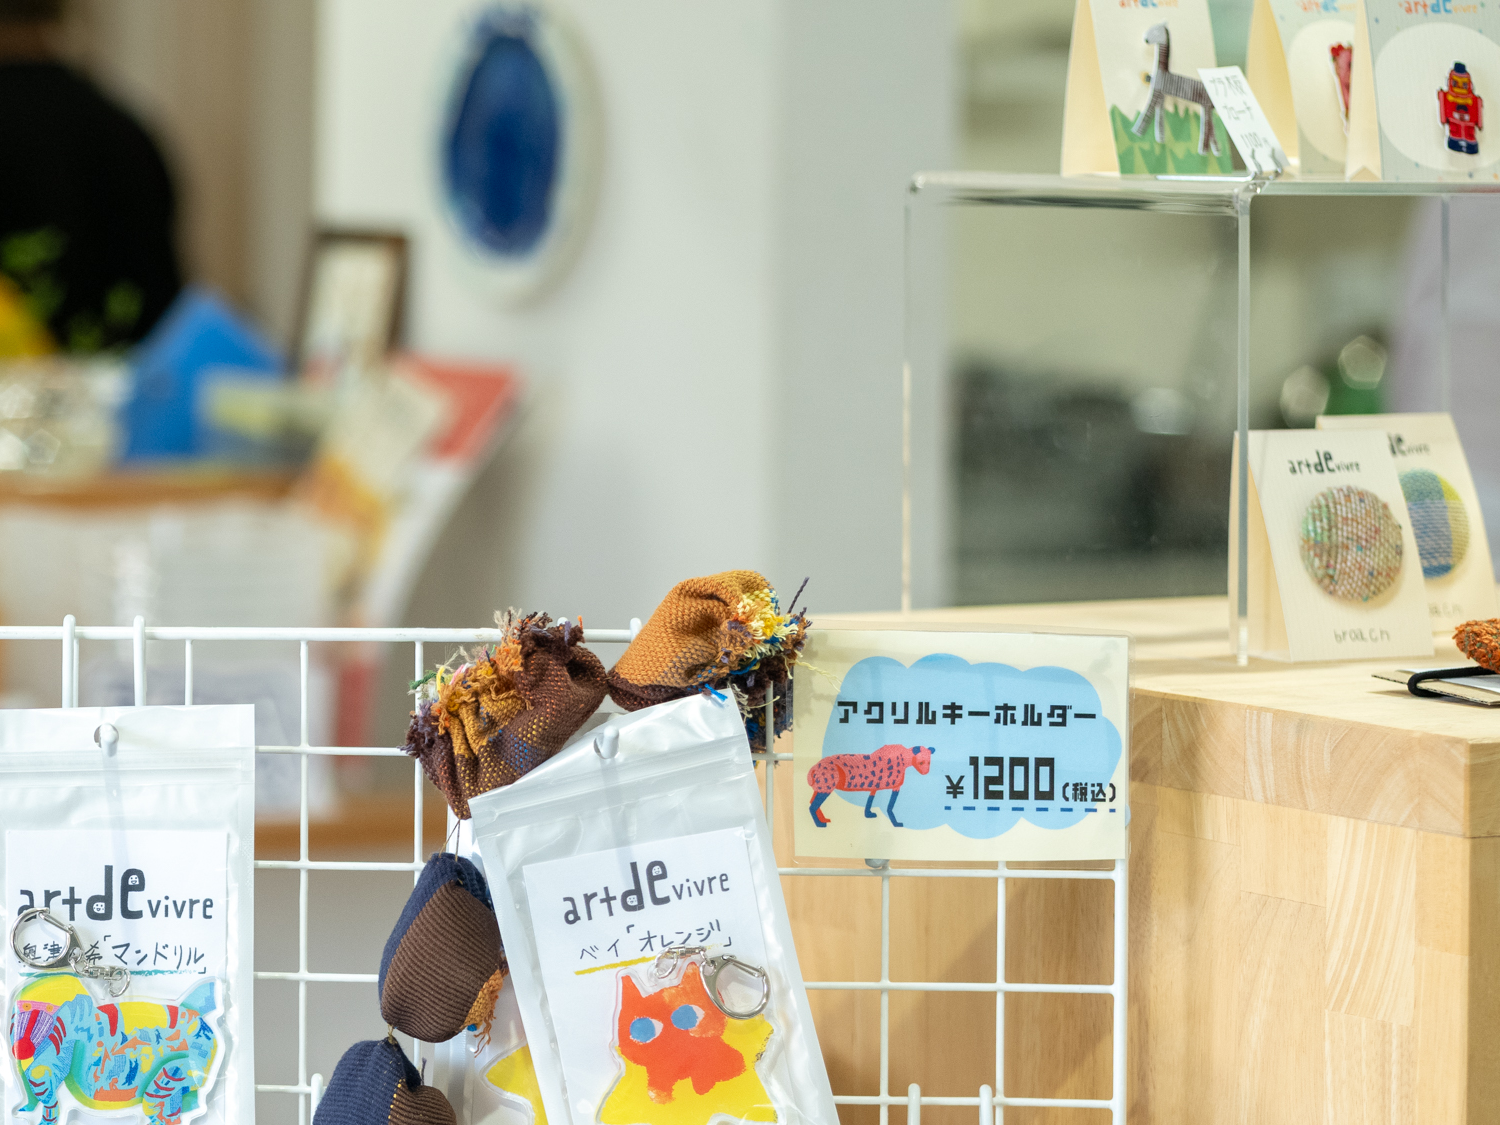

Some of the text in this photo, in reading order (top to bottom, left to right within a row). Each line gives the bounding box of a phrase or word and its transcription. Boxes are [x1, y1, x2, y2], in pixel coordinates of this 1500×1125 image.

[837, 701, 1097, 728] アクリルキーホルダー
